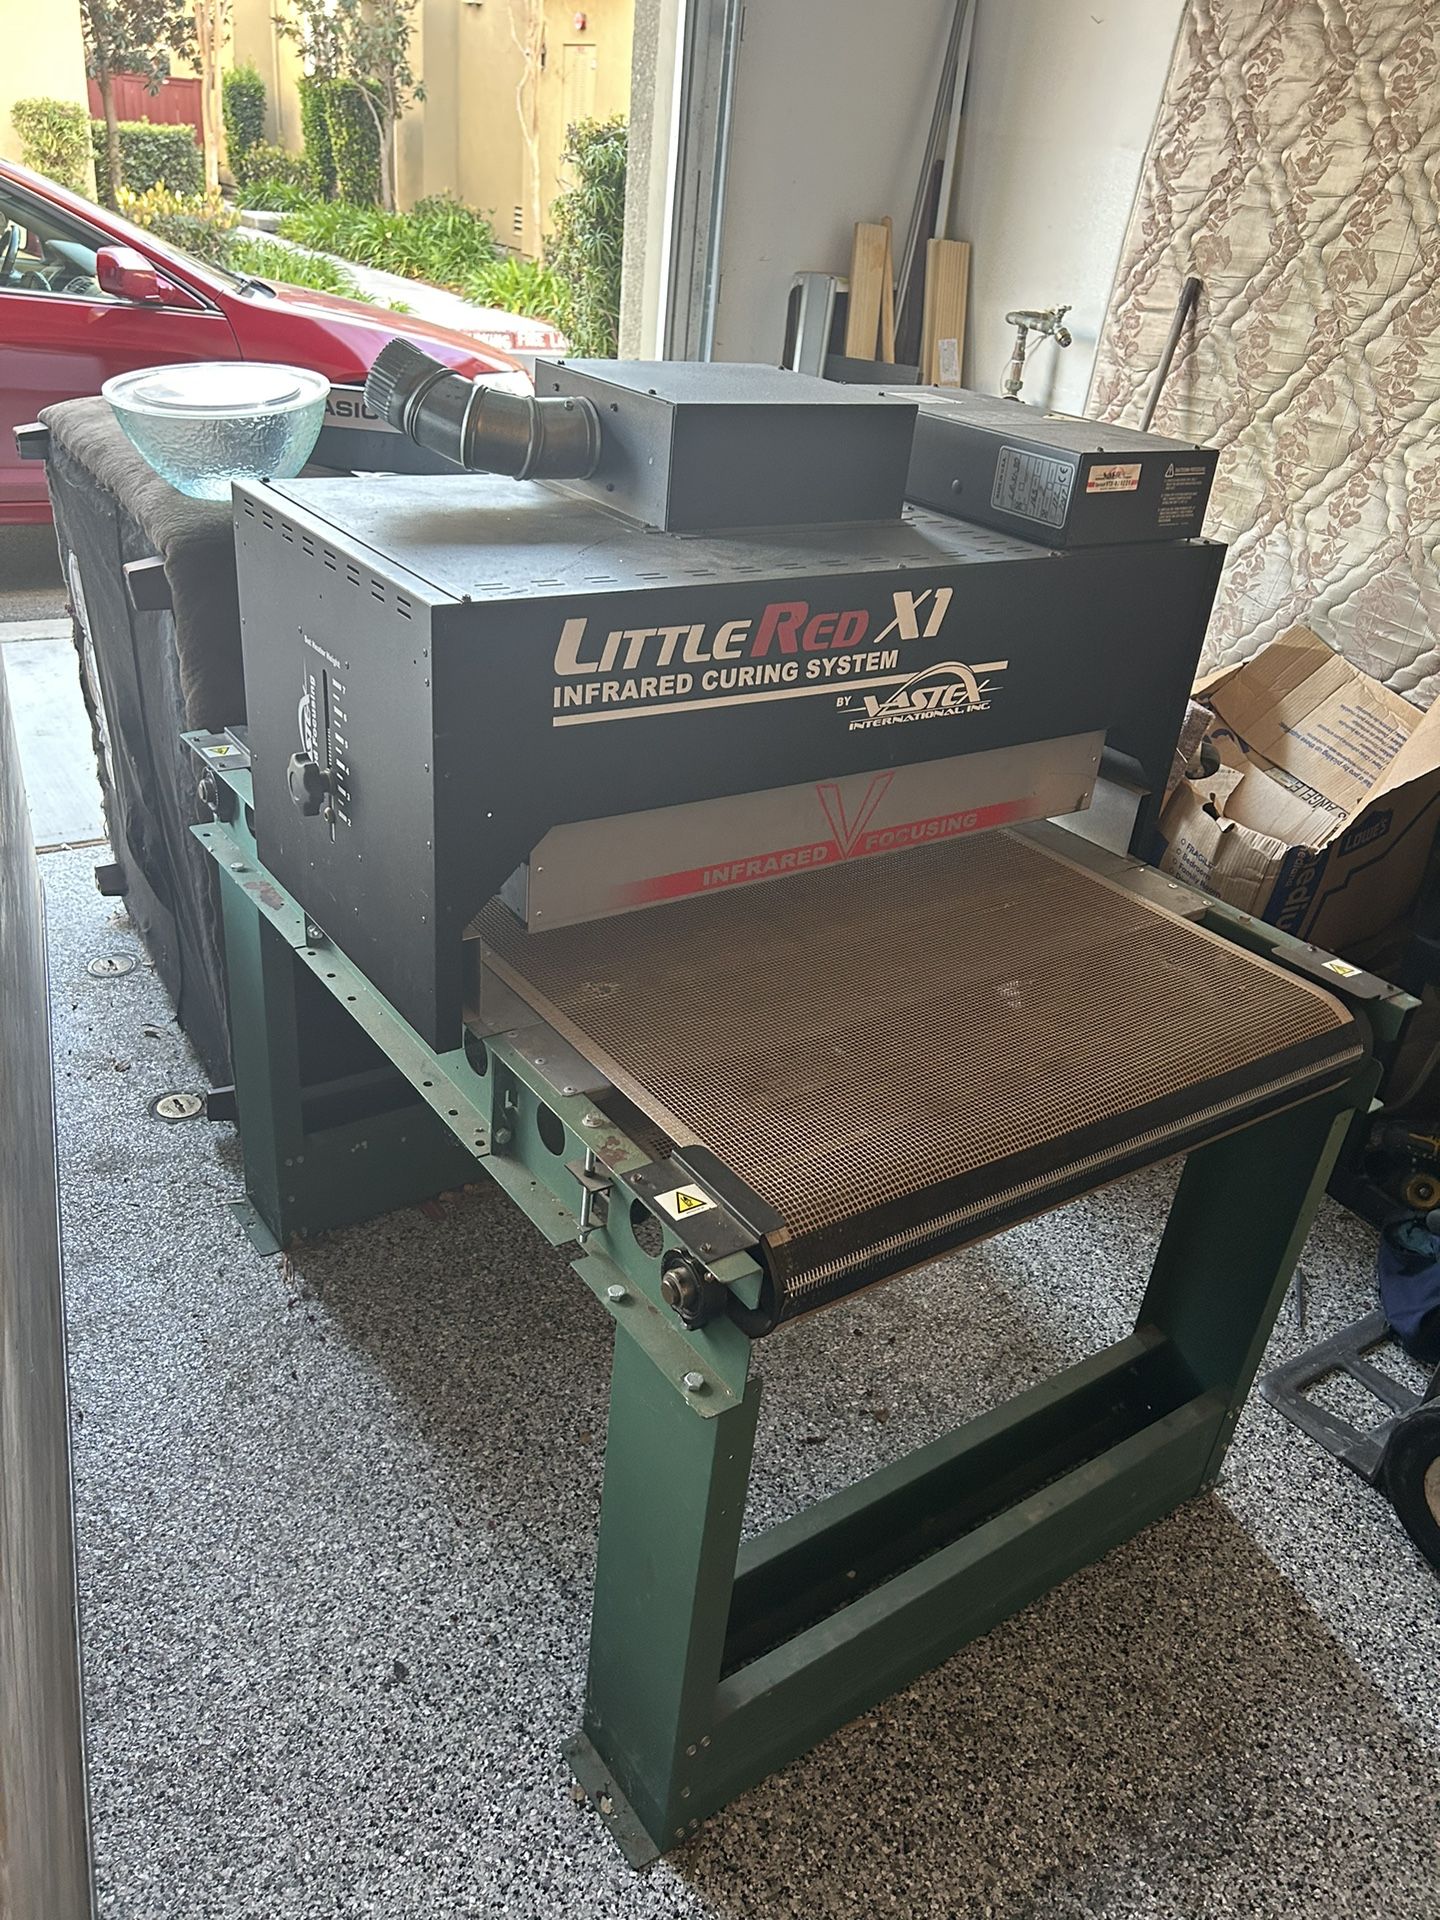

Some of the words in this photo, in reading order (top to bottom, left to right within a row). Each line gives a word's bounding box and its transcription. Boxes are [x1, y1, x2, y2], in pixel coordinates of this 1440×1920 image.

[873, 587, 953, 643] X1
[553, 673, 693, 708] INFRARED
[702, 661, 799, 691] CURING
[806, 649, 899, 679] SYSTEM
[836, 696, 852, 707] BY
[863, 661, 990, 718] VASTEX
[1300, 736, 1315, 748] these
[1321, 749, 1342, 766] picking
[1341, 763, 1350, 772] by
[1348, 768, 1361, 779] pro
[703, 846, 828, 886] INFRARED
[865, 813, 977, 850] FOCUSING
[1178, 862, 1200, 884] Family
[1182, 853, 1211, 881] Bedroom
